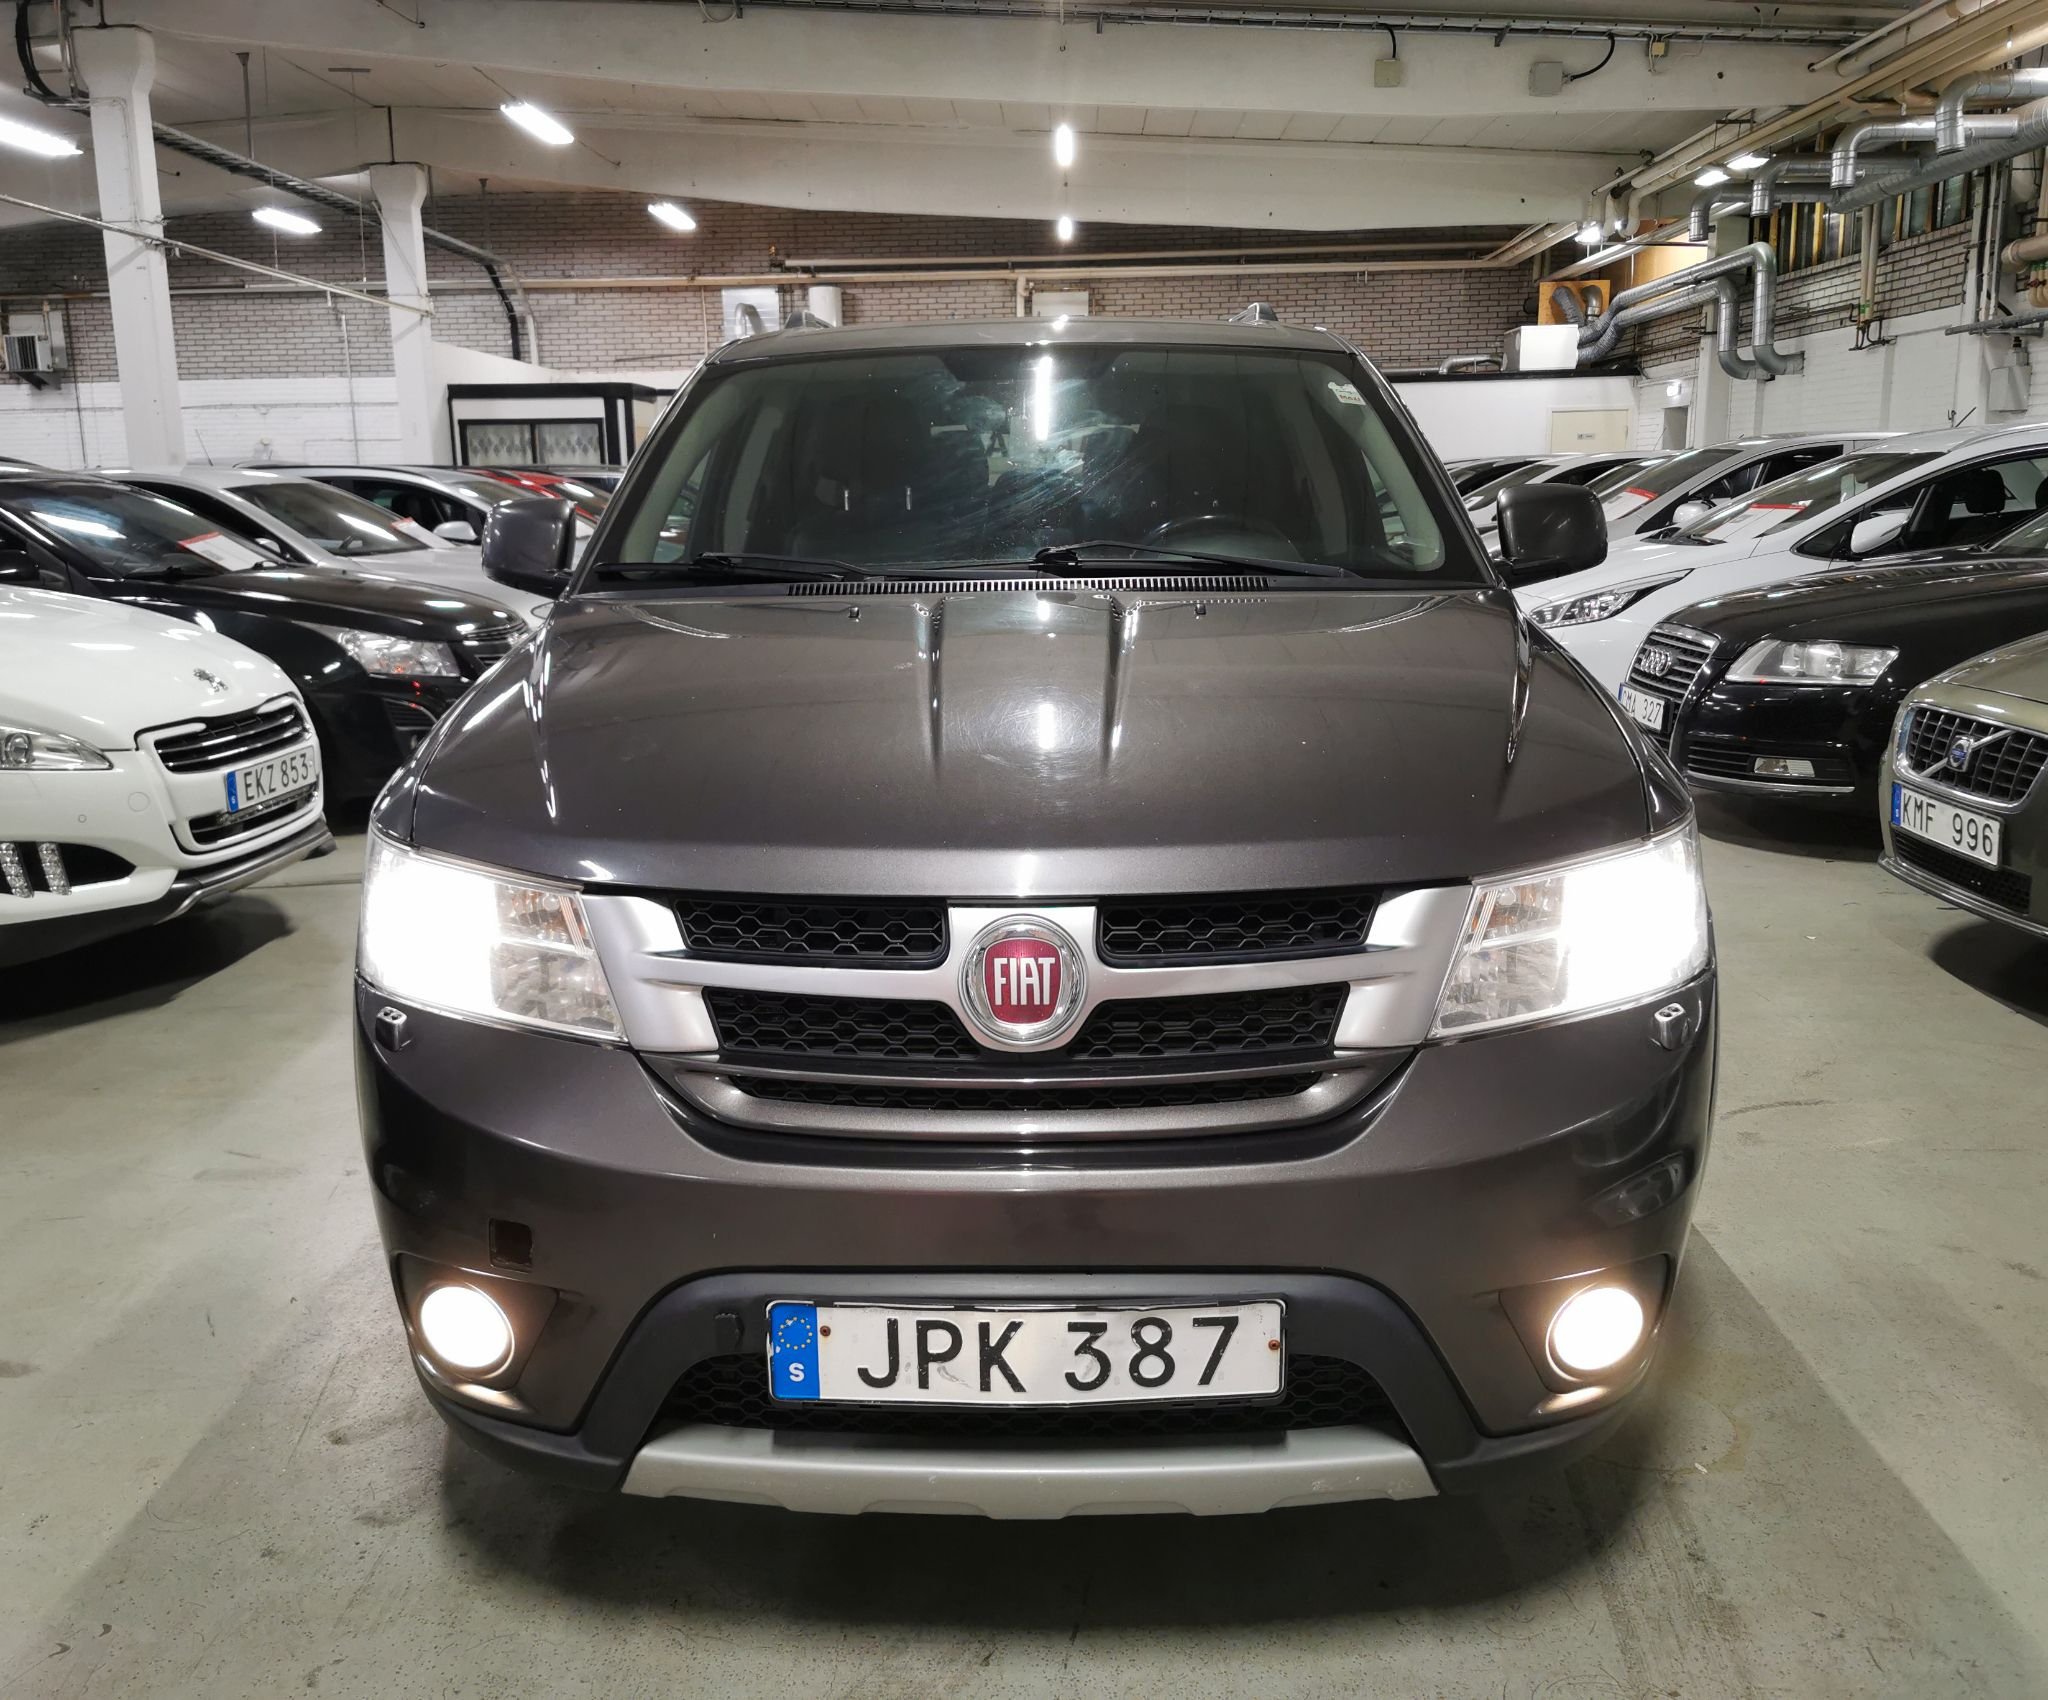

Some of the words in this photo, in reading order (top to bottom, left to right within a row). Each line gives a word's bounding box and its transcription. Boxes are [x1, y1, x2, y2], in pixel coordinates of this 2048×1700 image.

[1642, 698, 1662, 724] 327
[243, 763, 277, 802] EKZ
[280, 752, 309, 788] 853
[1902, 792, 1936, 833] KMF
[1952, 812, 1993, 857] 996
[994, 957, 1056, 1006] FIAT
[789, 1361, 805, 1383] S
[857, 1317, 1027, 1393] JPK
[1064, 1316, 1240, 1392] 387
